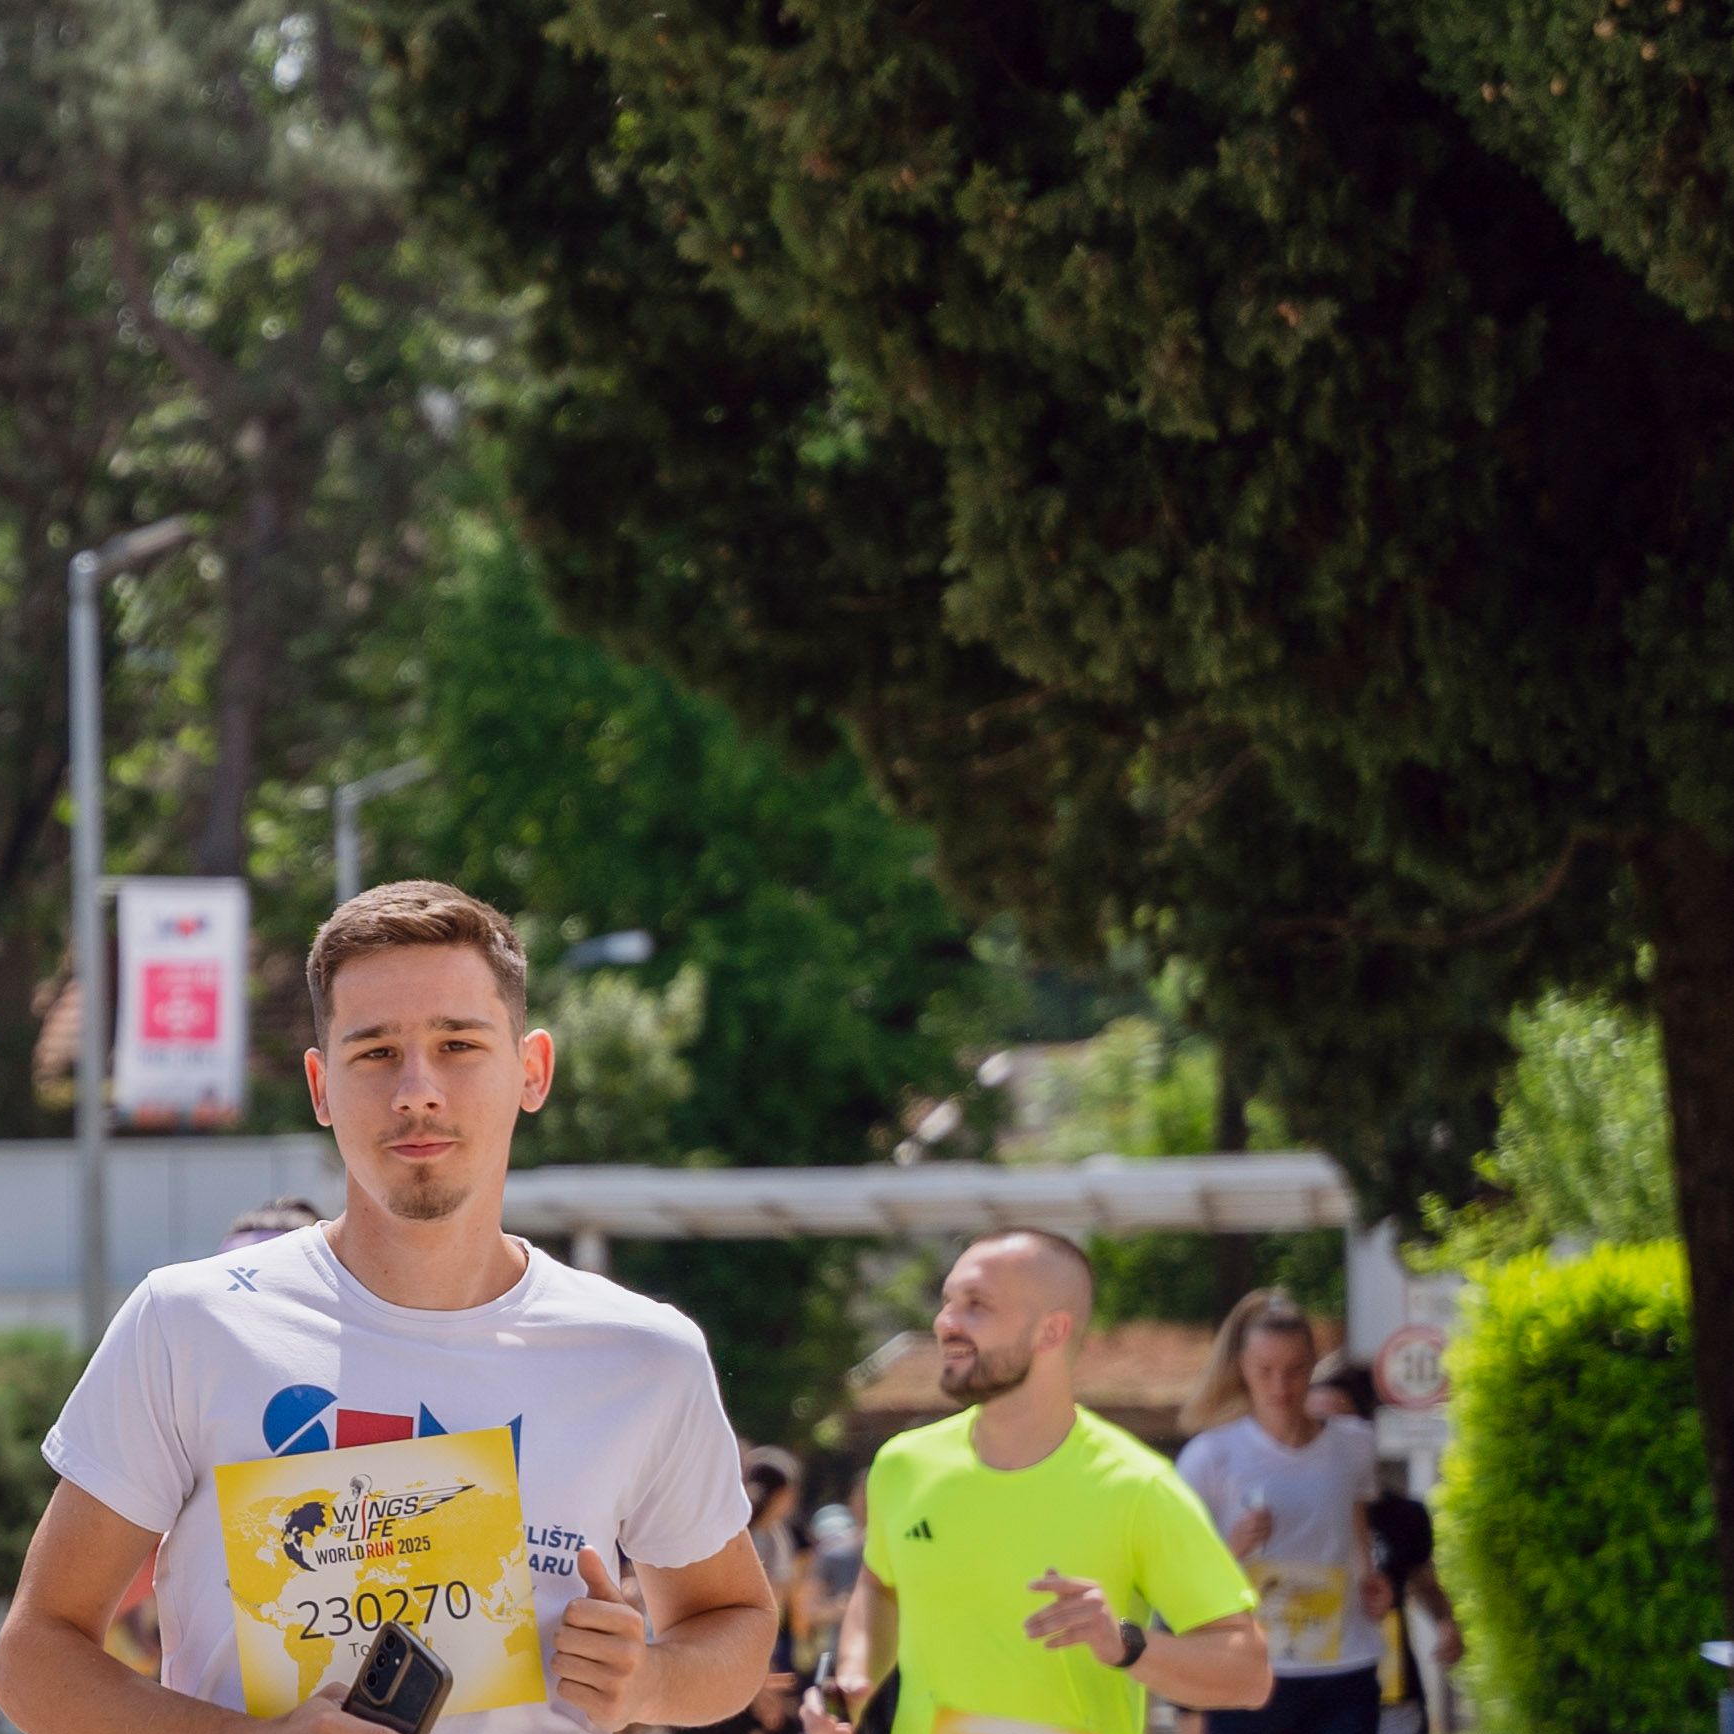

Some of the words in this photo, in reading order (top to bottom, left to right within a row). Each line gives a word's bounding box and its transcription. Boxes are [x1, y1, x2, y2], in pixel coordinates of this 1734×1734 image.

[331, 1495, 419, 1524] WINGS
[347, 1518, 396, 1542] LIFE
[398, 1535, 431, 1554] 2025
[296, 1580, 471, 1641] 230270
